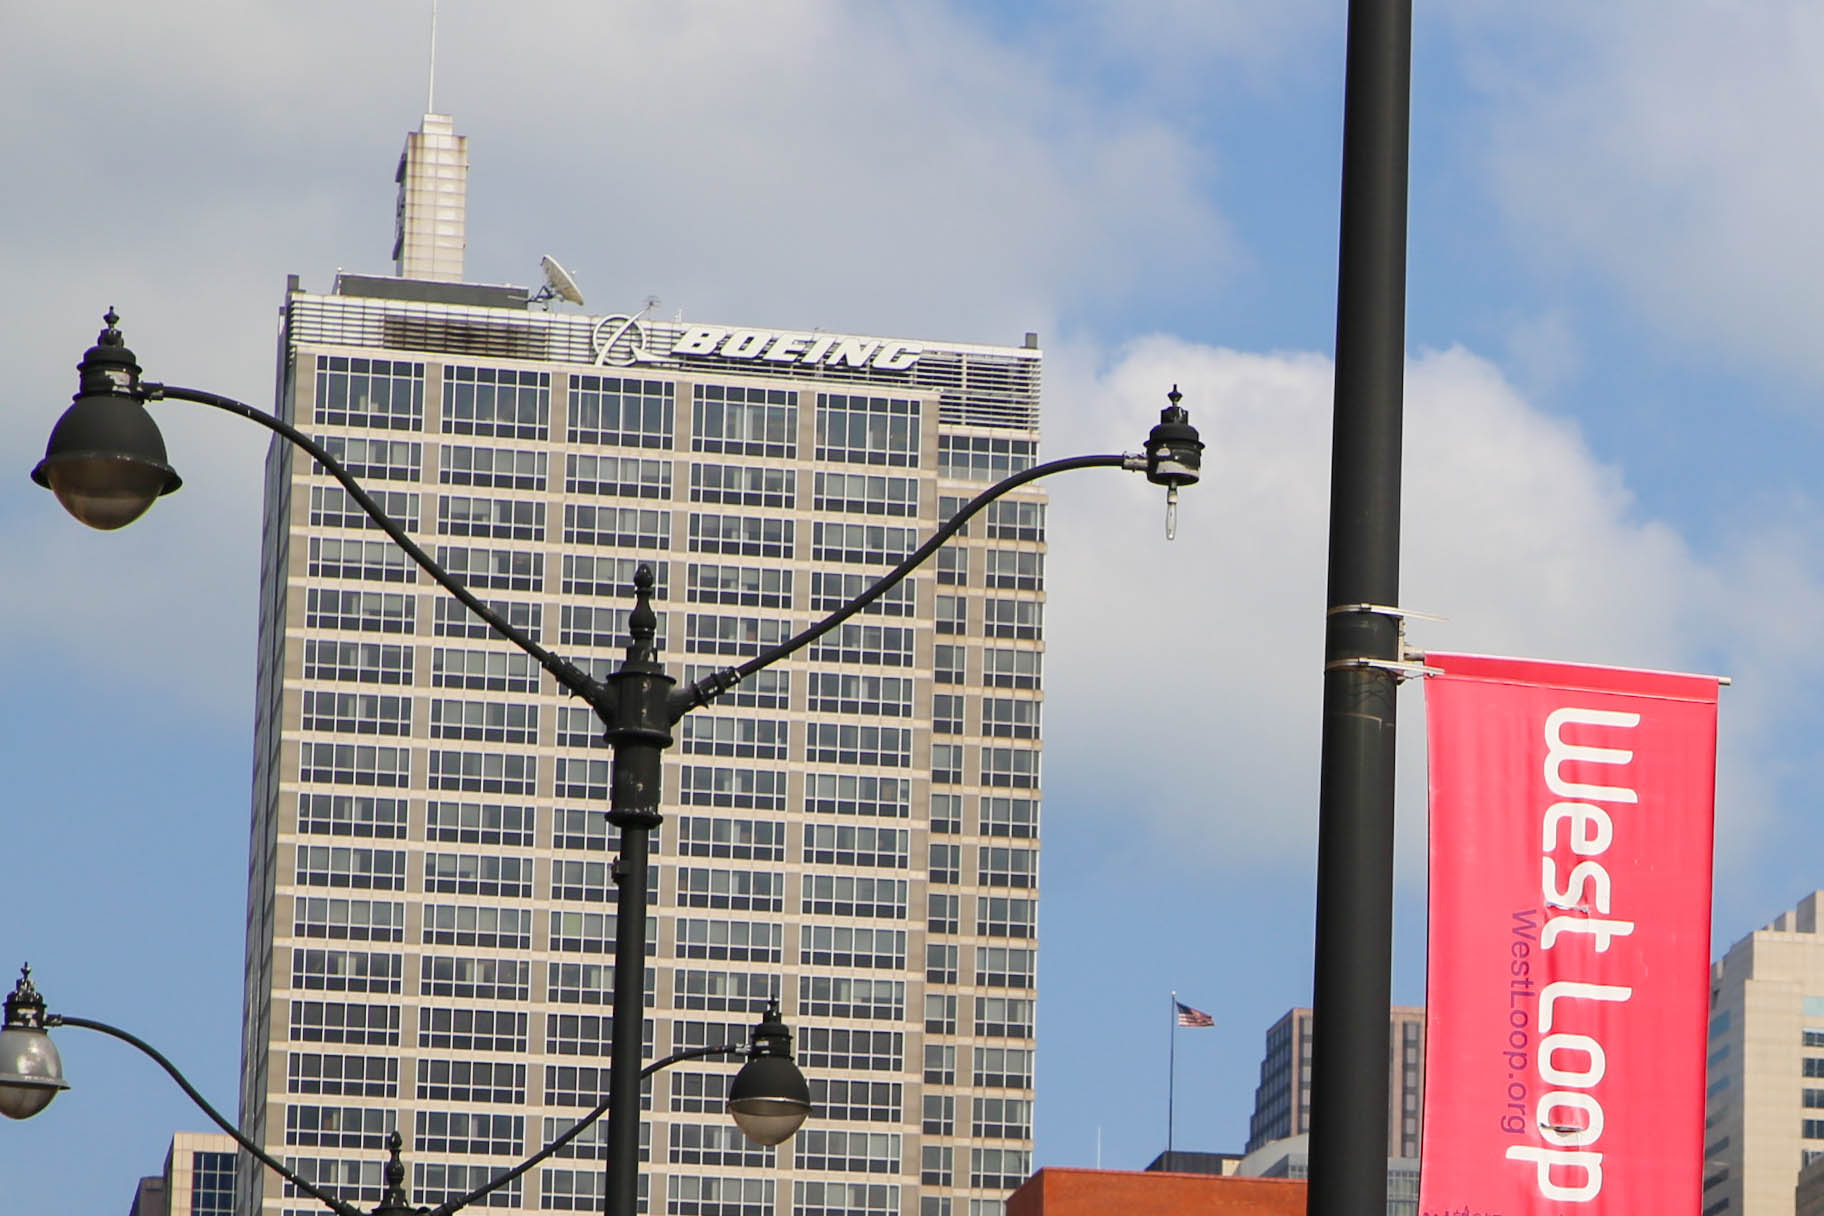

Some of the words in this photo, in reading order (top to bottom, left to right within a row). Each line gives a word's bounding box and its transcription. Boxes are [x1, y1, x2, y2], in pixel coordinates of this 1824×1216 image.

[670, 327, 924, 370] BOEING
[1541, 707, 1640, 953] West
[1501, 908, 1537, 1136] WestLoop.org
[1505, 981, 1633, 1203] Loop
